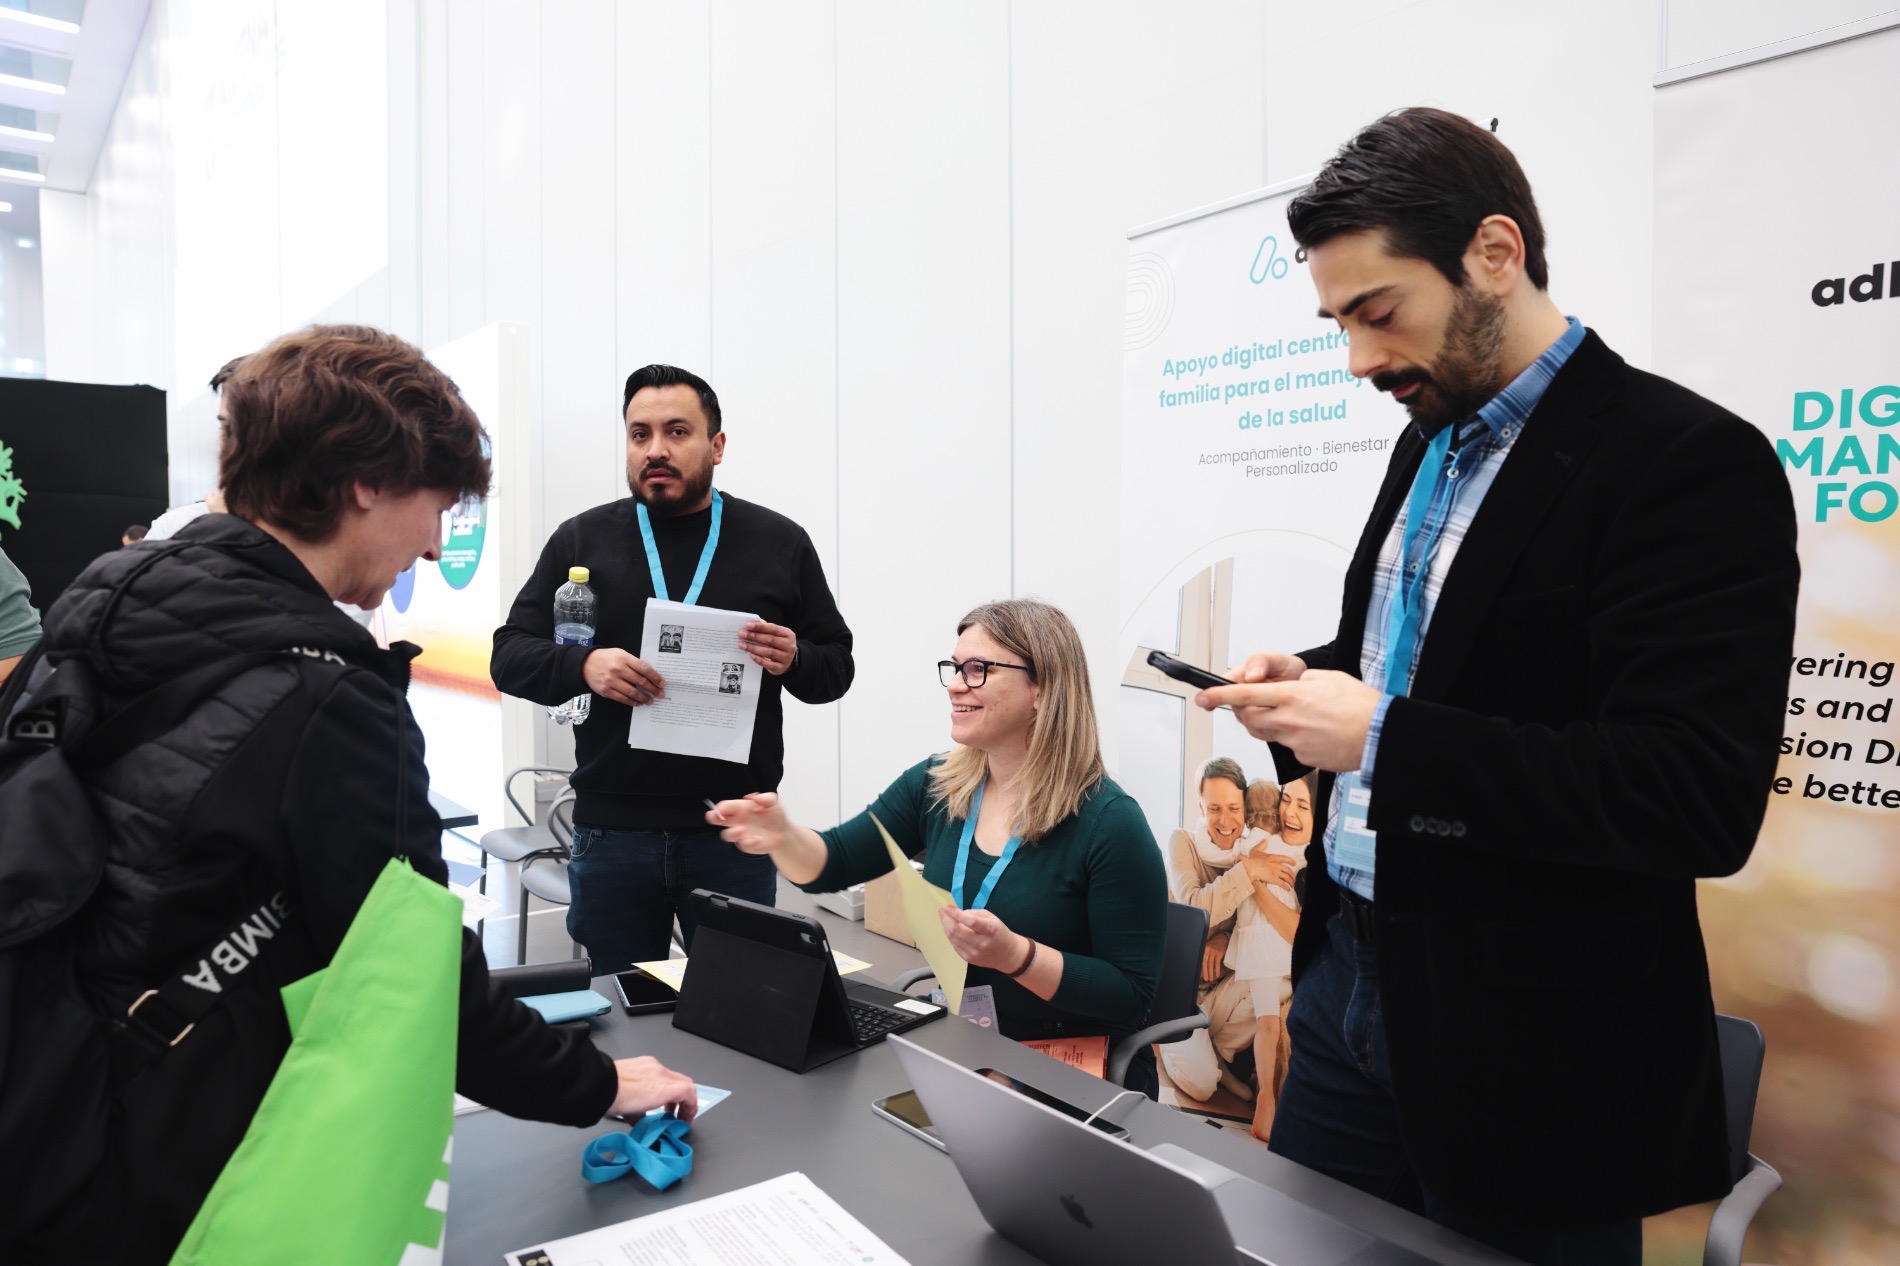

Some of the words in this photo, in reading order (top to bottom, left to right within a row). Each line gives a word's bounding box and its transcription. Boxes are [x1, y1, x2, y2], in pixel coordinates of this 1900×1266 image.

[1162, 354, 1218, 381] Apoyo
[1221, 338, 1282, 370] digital
[1159, 382, 1220, 408] familia
[1224, 379, 1270, 405] para
[1274, 371, 1290, 392] el
[1238, 411, 1263, 430] de
[1267, 408, 1284, 427] la
[1288, 399, 1347, 424] salud
[1199, 444, 1312, 466] Acompañamiento
[1322, 437, 1390, 455] Bienestar
[1246, 458, 1338, 478] Personalizado
[1816, 698, 1894, 723] and
[1865, 739, 1900, 767] D
[1803, 773, 1900, 808] bette
